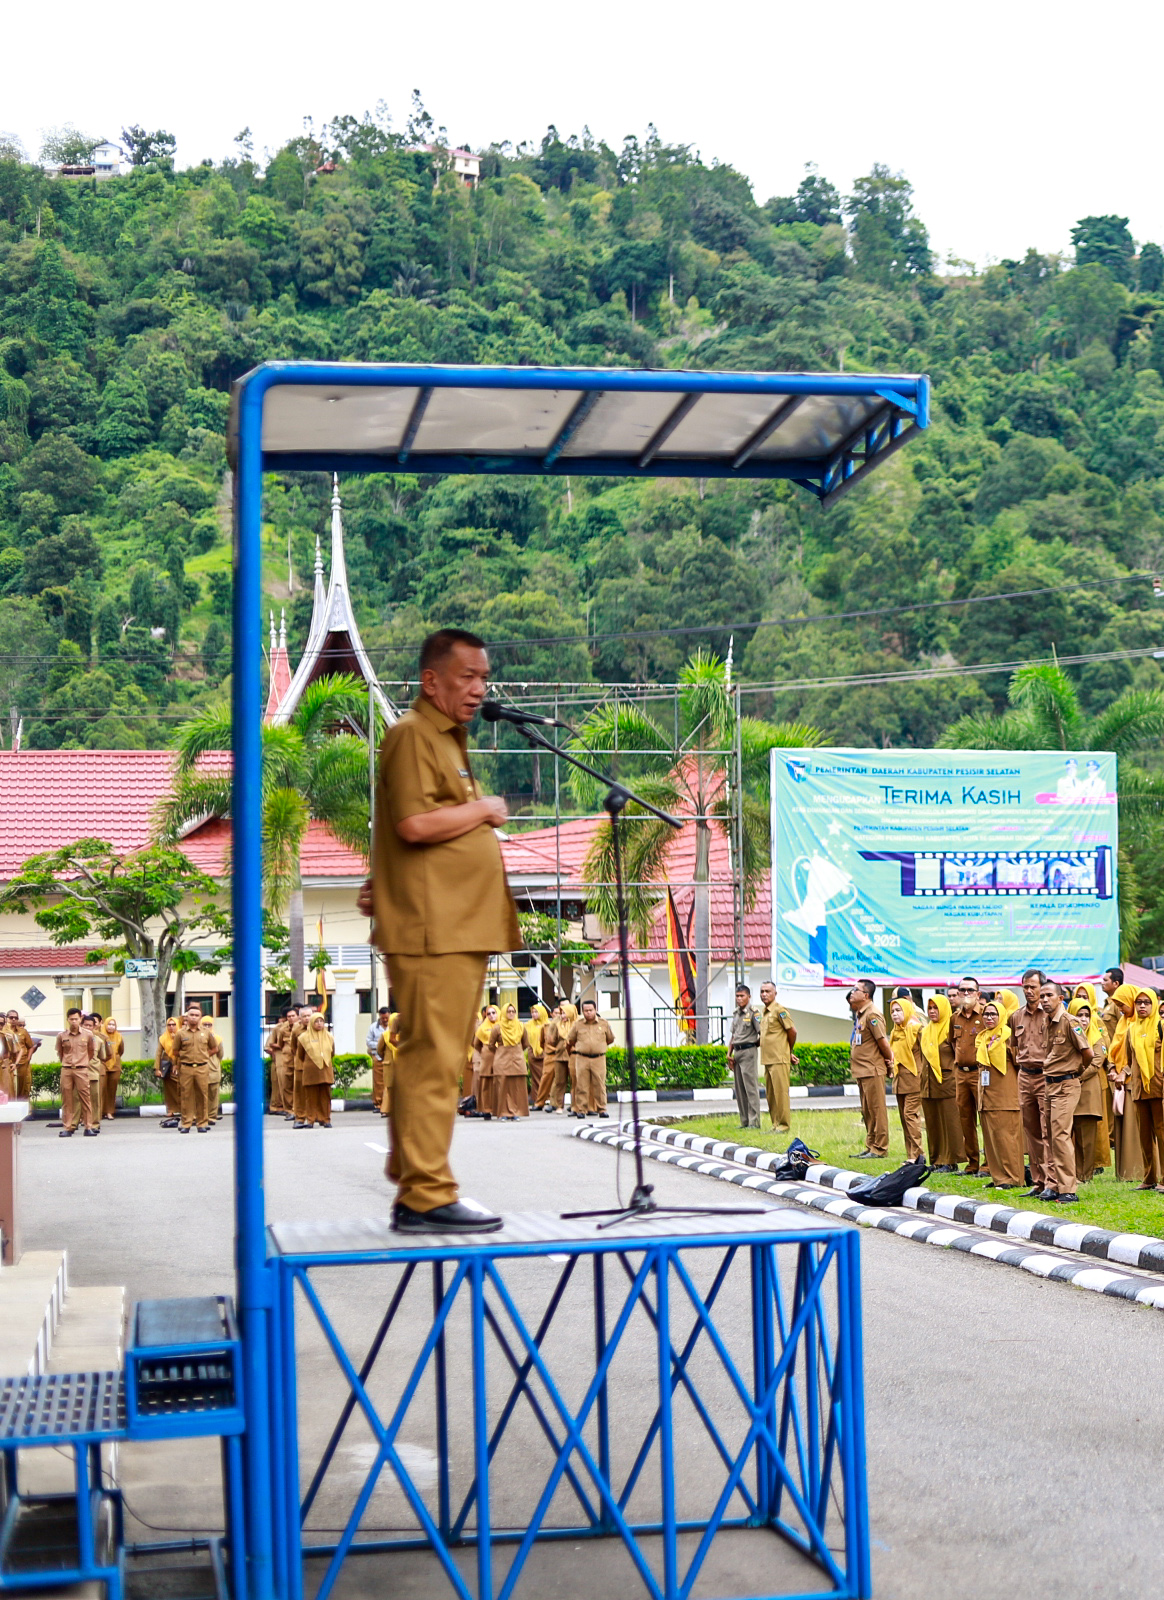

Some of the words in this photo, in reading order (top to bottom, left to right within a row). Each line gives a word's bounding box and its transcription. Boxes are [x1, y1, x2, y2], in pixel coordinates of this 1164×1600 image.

[815, 766, 868, 774] PEMERINTAH
[871, 767, 905, 775] DAERAH
[873, 934, 901, 947] 2021
